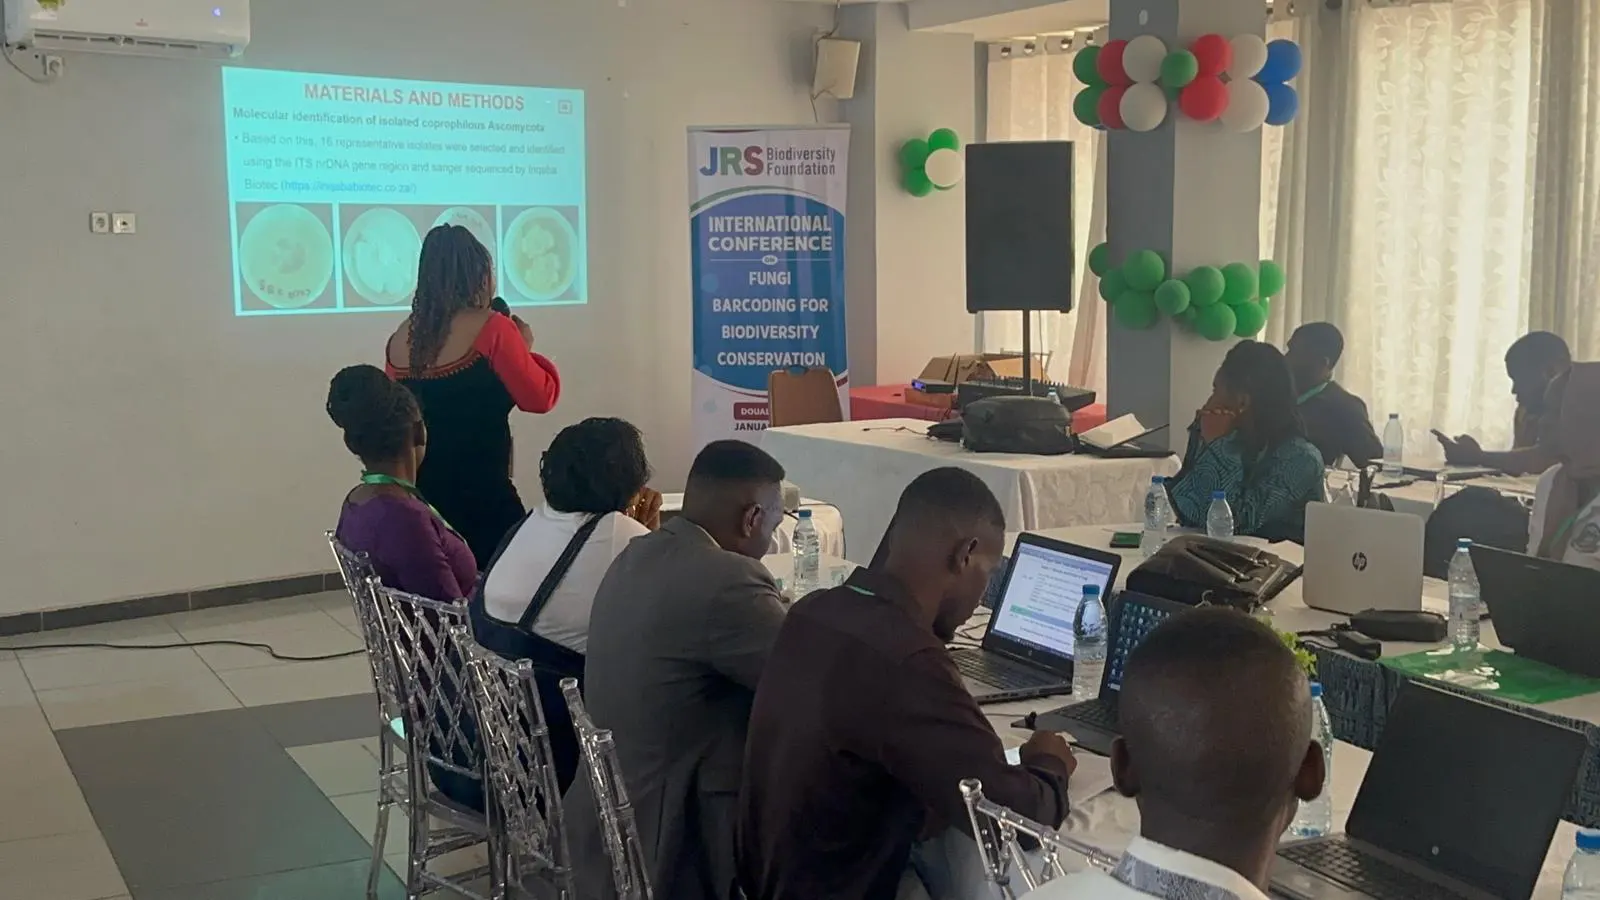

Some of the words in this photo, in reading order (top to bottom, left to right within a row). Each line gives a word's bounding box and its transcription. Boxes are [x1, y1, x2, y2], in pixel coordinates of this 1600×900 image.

[303, 83, 403, 105] MATERIALS
[408, 90, 443, 107] AND
[447, 93, 525, 111] METHODS
[232, 107, 289, 120] Molecular
[292, 112, 363, 124] identification
[366, 115, 376, 125] of
[379, 116, 419, 127] isolated
[421, 118, 486, 131] coprophilous
[242, 132, 276, 144] Based
[279, 136, 293, 144] on
[508, 145, 525, 153] and
[699, 146, 764, 176] JRS
[766, 147, 836, 163] Biodiversity
[275, 157, 292, 167] the
[294, 157, 313, 168] ITS
[411, 162, 429, 171] and
[766, 162, 836, 176] Foundation
[244, 178, 279, 190] Biotec
[708, 215, 832, 233] INTERNATIONAL
[708, 236, 832, 251] CONFERENCE
[749, 271, 791, 285] FUNGI
[712, 298, 796, 313] BARCODING
[800, 299, 829, 313] FOR
[721, 325, 820, 339] BIODIVERSITY
[717, 352, 826, 366] CONSERVATION
